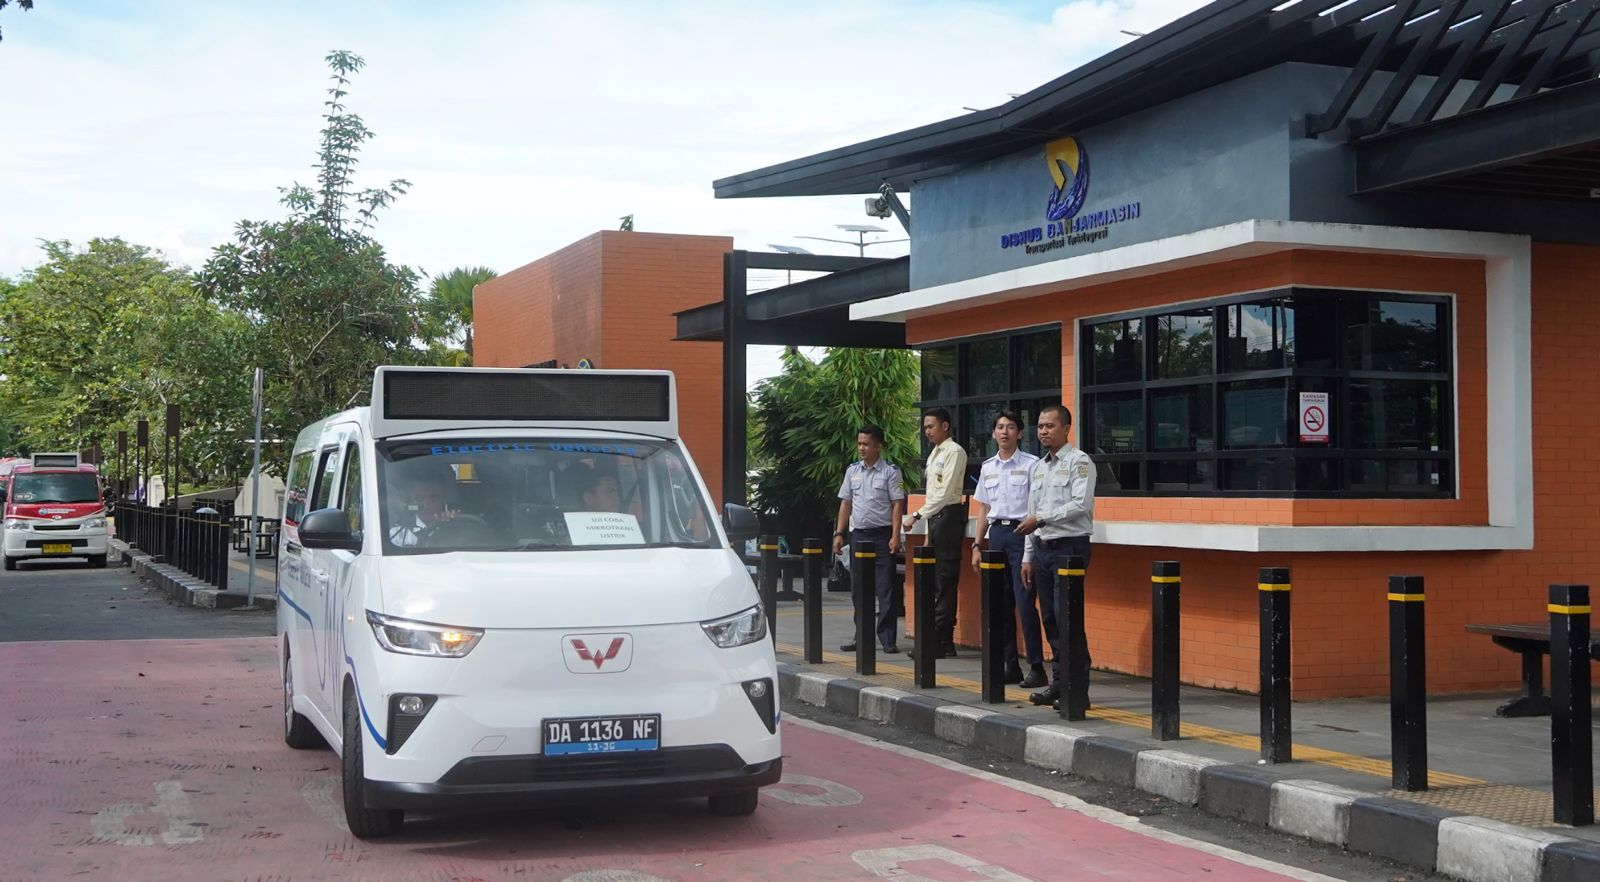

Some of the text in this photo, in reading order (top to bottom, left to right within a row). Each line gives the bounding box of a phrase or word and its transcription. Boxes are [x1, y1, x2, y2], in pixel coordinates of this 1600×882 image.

[1001, 202, 1140, 249] DISHUB BANJARMASIN
[1025, 236, 1065, 254] Transportasi
[431, 443, 537, 456] Electric
[549, 719, 655, 743] DA 1136 NF
